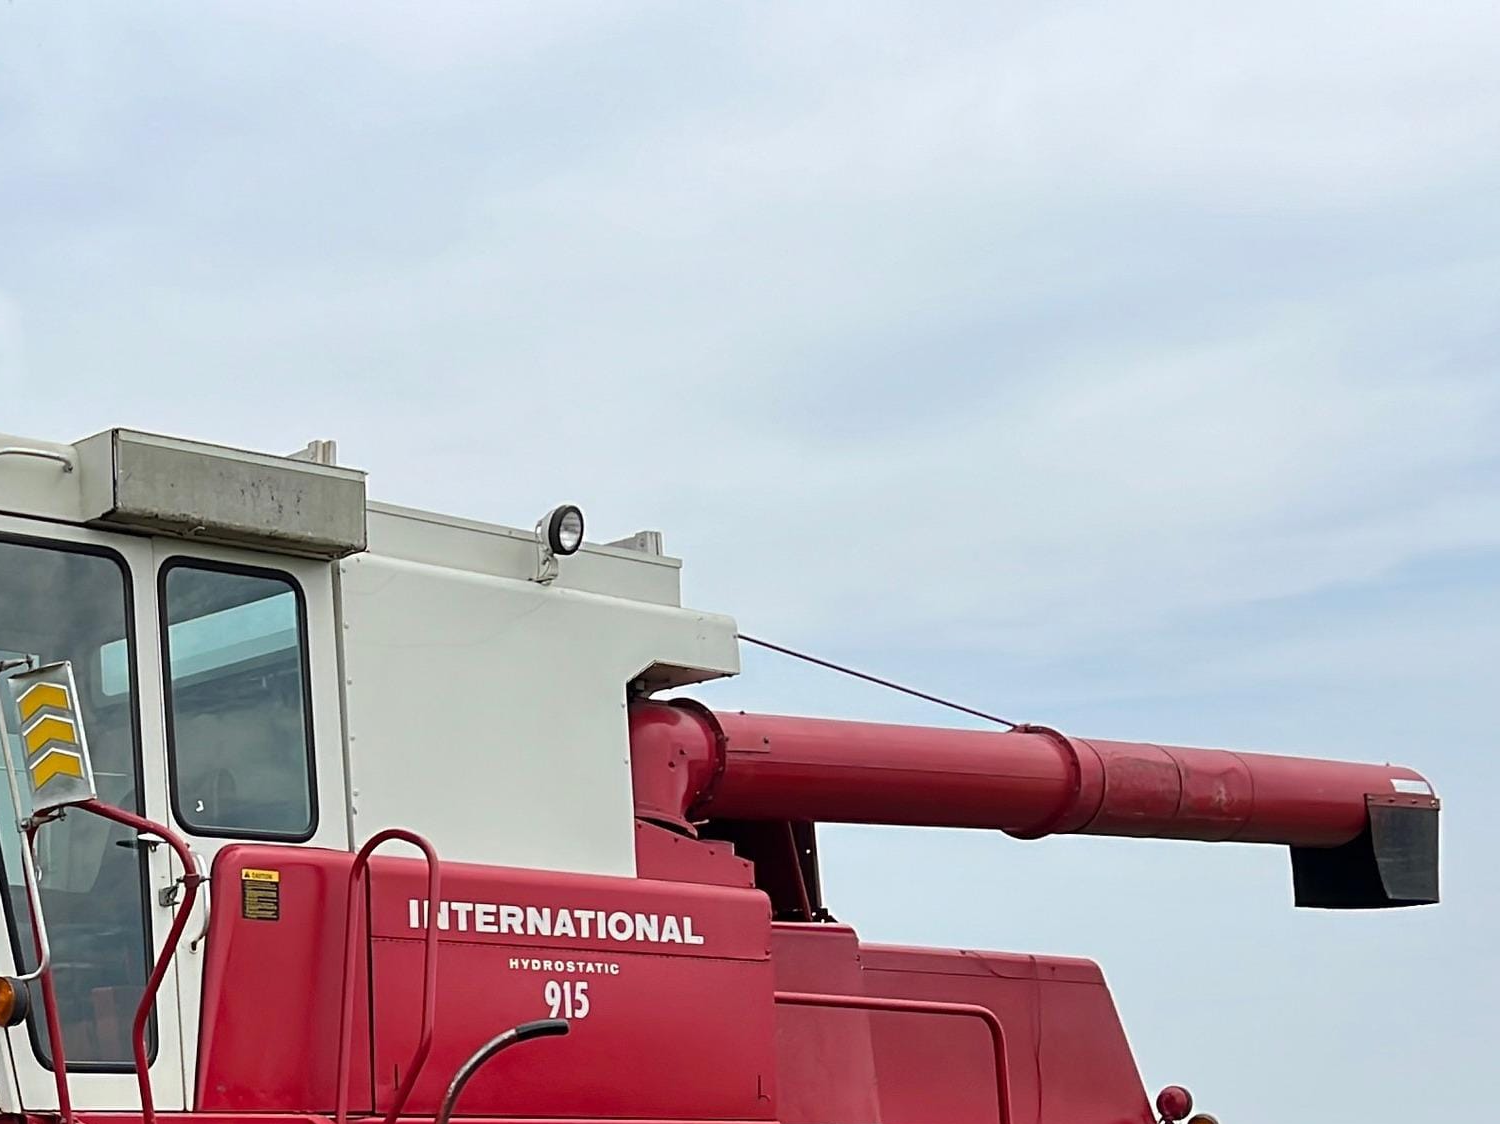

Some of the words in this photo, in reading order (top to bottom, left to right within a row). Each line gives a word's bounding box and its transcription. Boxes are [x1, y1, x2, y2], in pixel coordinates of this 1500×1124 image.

[409, 899, 704, 945] INTERNATIONAL
[509, 958, 620, 975] HYDROSTATIC
[544, 980, 590, 1019] 915
